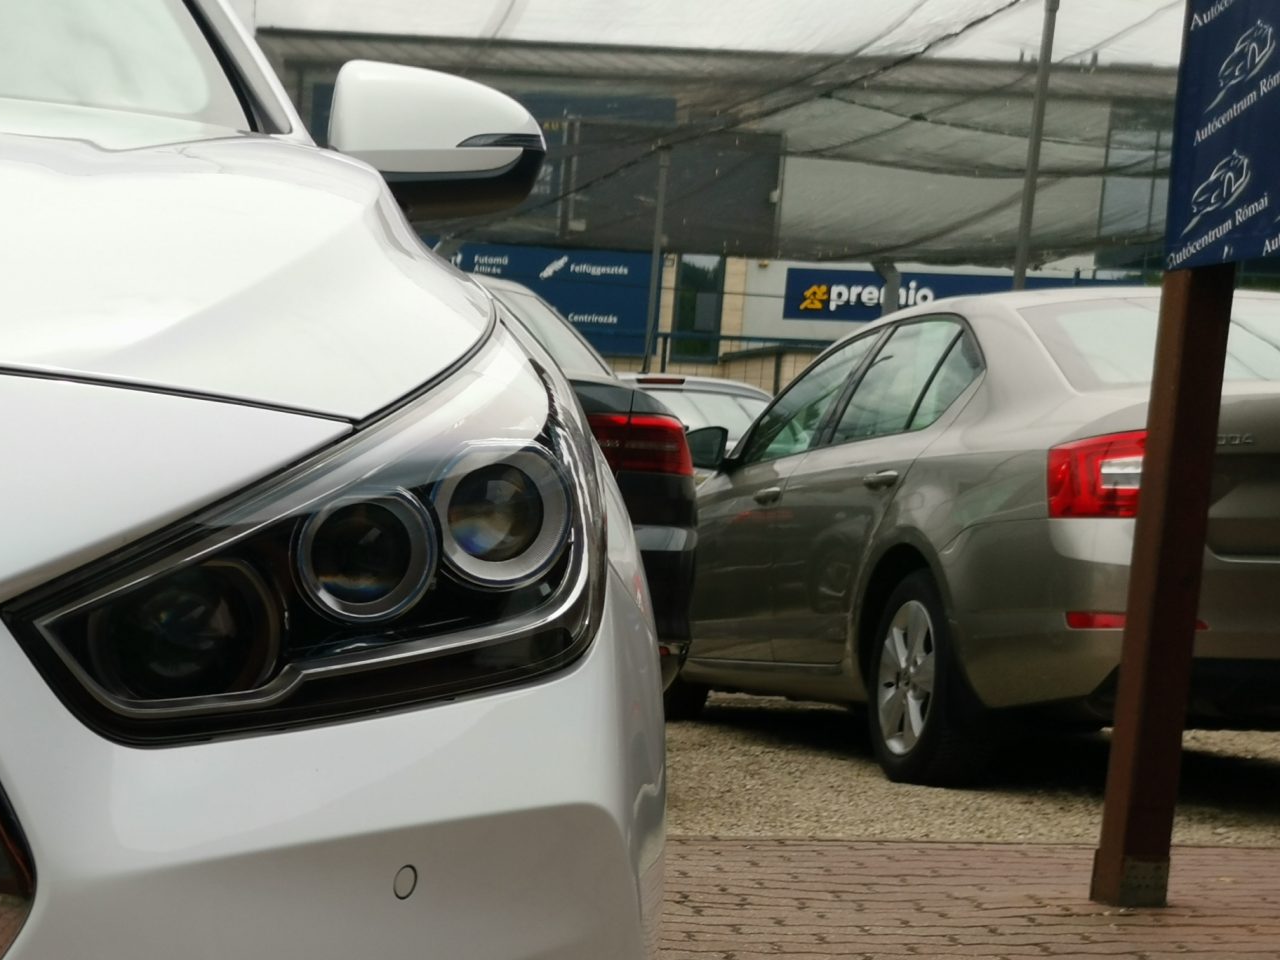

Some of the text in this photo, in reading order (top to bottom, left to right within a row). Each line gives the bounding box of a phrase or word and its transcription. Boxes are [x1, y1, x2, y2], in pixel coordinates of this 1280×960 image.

[1193, 90, 1257, 147] Autócentrum
[1235, 192, 1268, 226] Római
[570, 263, 628, 276] Felfüggesztés
